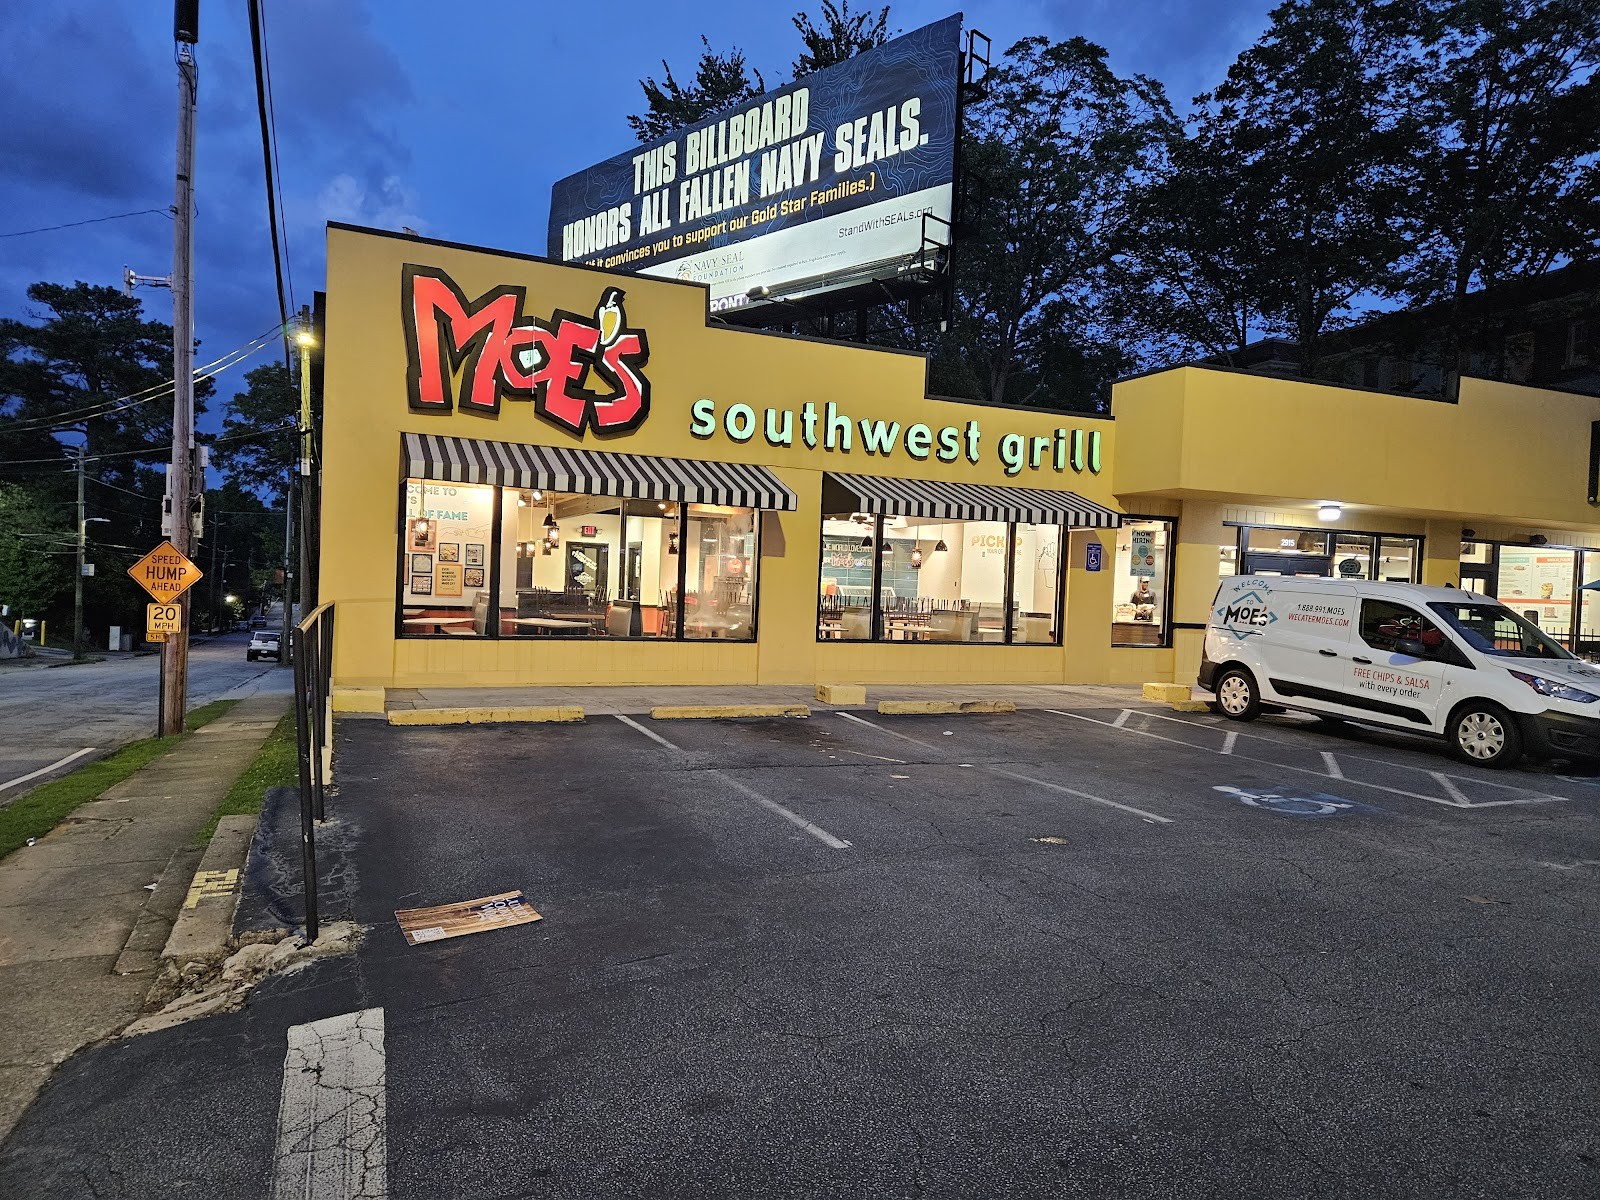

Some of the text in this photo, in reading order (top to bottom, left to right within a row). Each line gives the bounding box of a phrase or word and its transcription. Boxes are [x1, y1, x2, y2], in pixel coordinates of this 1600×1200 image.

[633, 87, 810, 195] THIS BILLBOARD
[562, 97, 929, 261] HONORS ALL FALLEN NAVY SEALS.
[605, 244, 651, 268] convinces
[652, 238, 670, 256] you
[673, 235, 683, 247] to
[685, 222, 727, 244] support
[729, 214, 749, 231] our
[751, 202, 777, 225] Gold
[781, 195, 807, 215] Star
[693, 250, 745, 273] NAVY SEAL
[693, 264, 745, 281] FOUNDATION
[690, 398, 1102, 475] southwest grill
[436, 510, 468, 521] FAME
[1281, 538, 1295, 547] 2915
[151, 555, 181, 565] SPEED
[146, 566, 187, 581] HUMP
[150, 582, 181, 592] AHEAD
[1233, 580, 1273, 595] WELCOME
[153, 606, 176, 621] 20
[1288, 613, 1350, 626] WECATERMOES.COM
[154, 622, 174, 630] MPH
[1353, 667, 1430, 689] FREE CHIPS & SALSA
[1359, 680, 1421, 698] with every order
